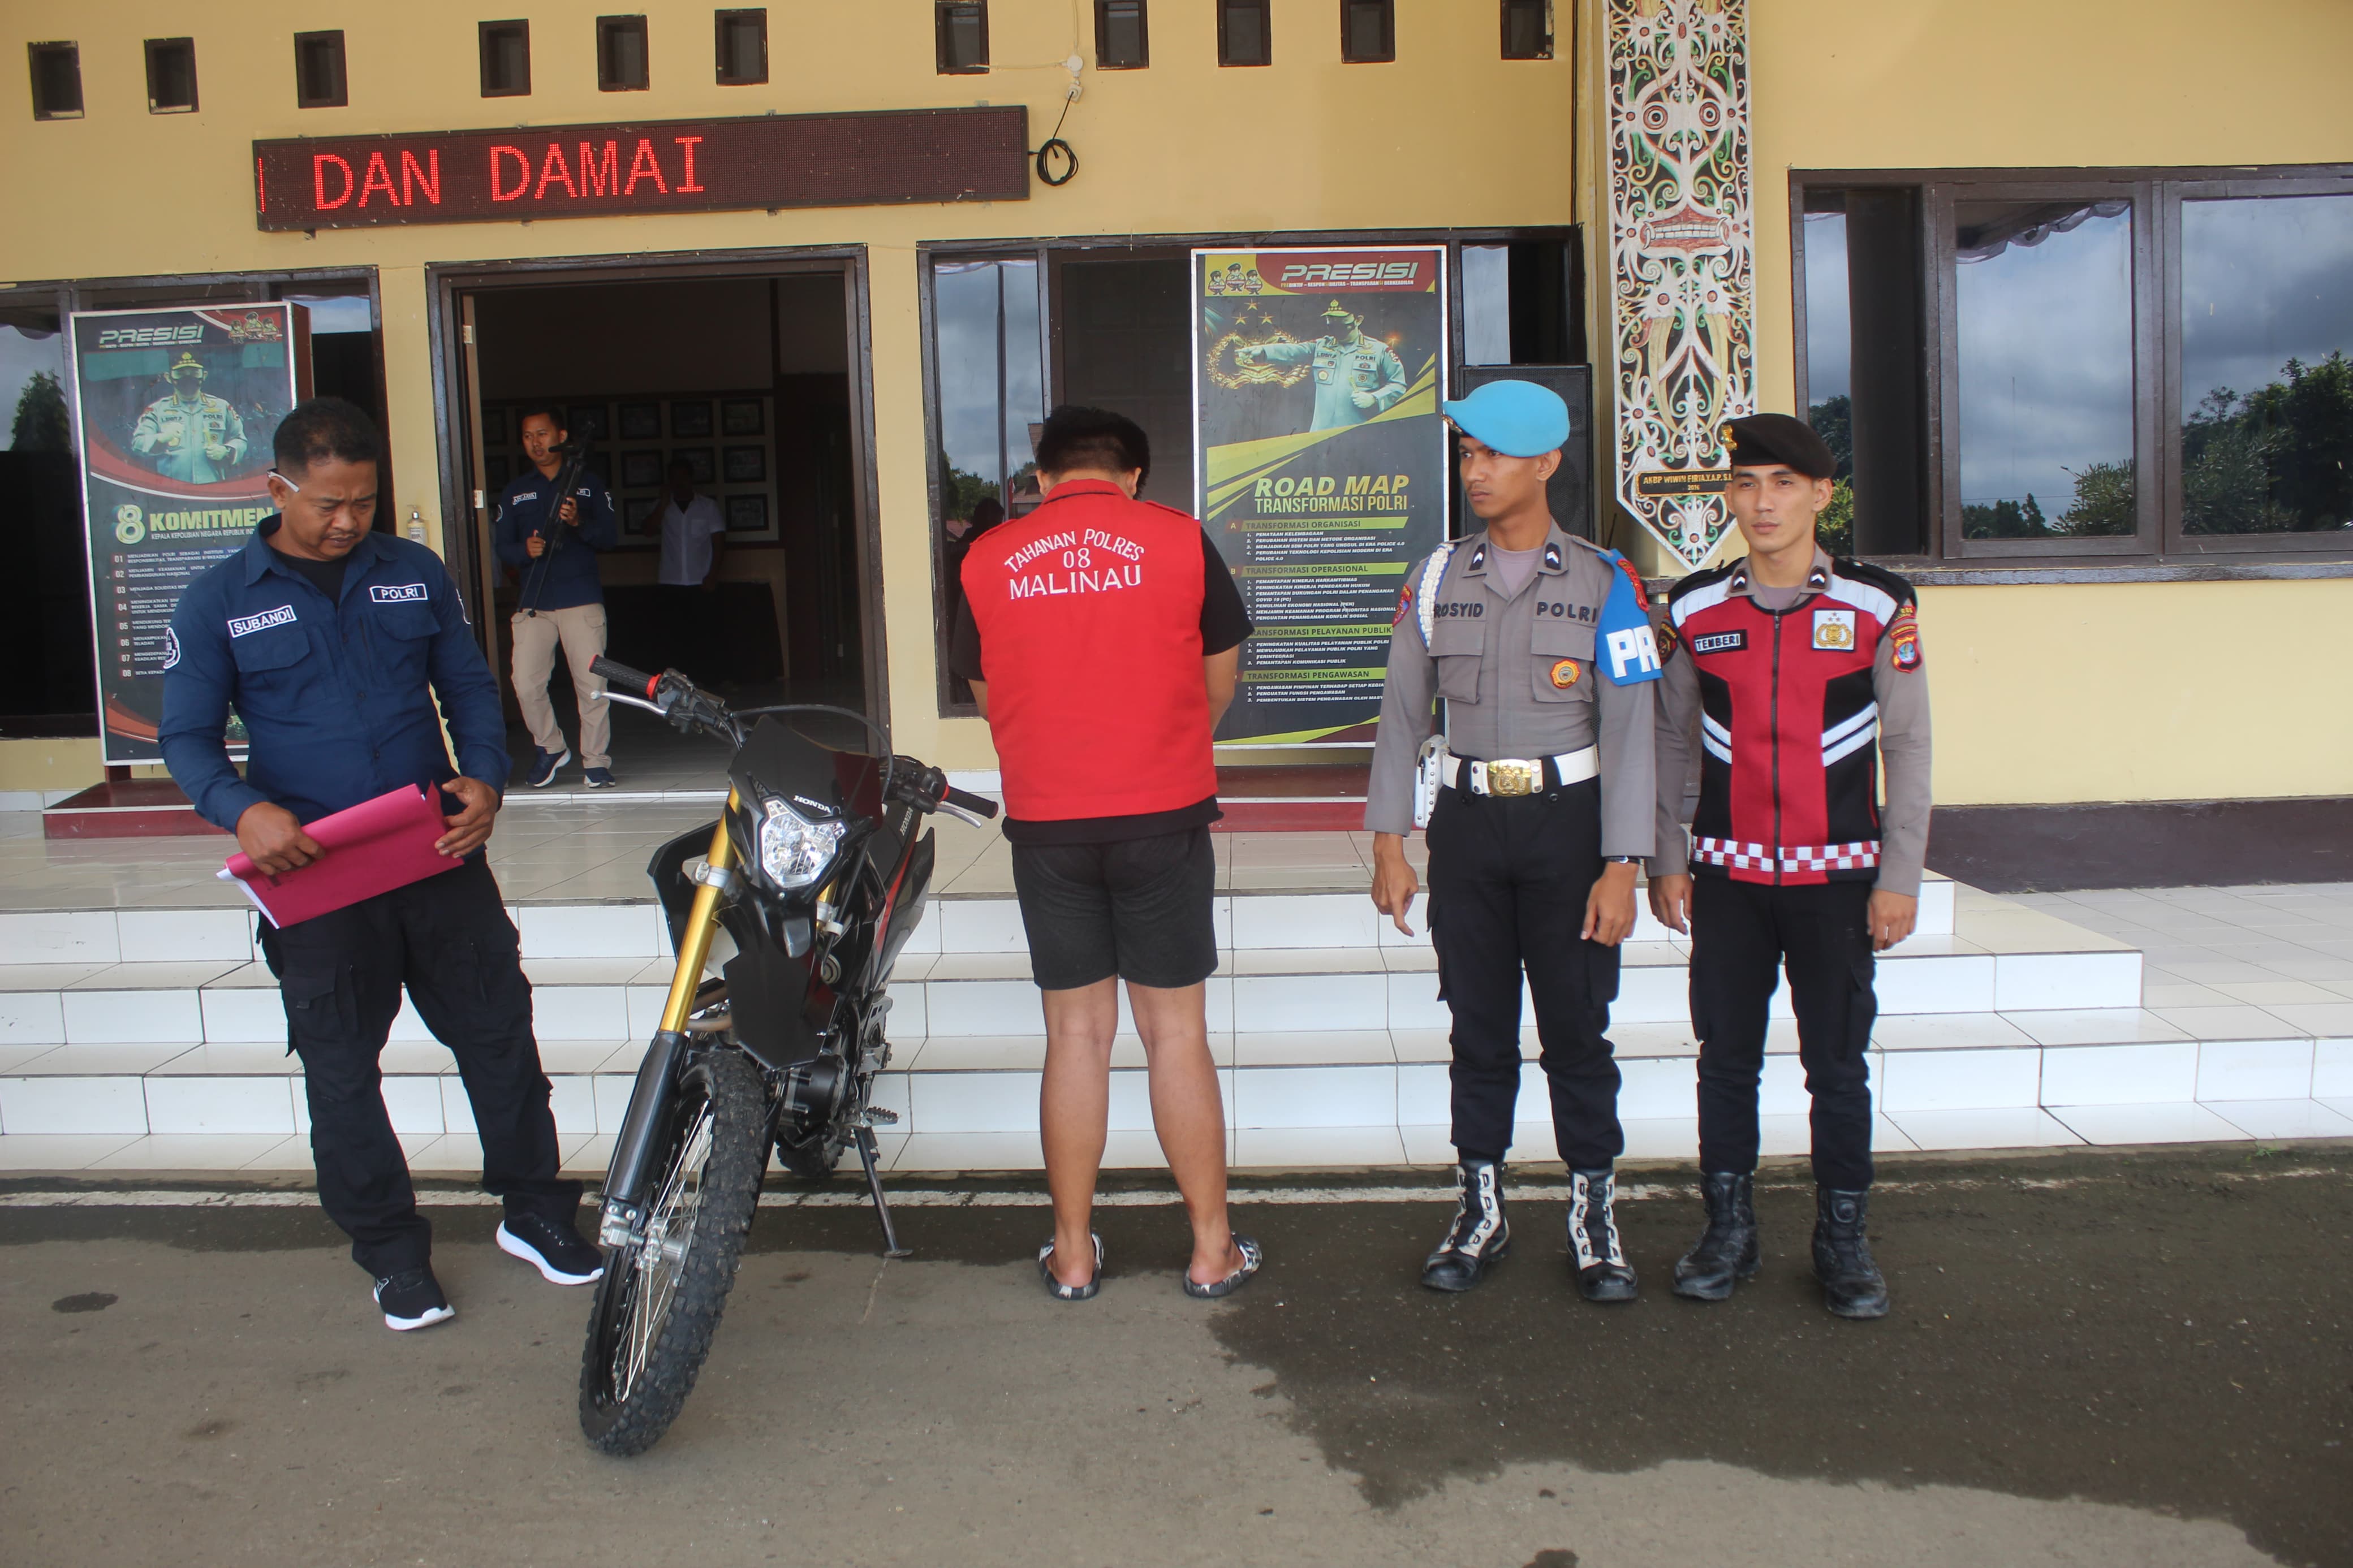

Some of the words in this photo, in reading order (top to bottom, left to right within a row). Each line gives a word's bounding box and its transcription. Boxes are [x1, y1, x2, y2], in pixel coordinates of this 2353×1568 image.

[314, 149, 440, 210] DAN
[490, 136, 705, 202] DAMAI
[1281, 262, 1419, 281] PRESISI
[100, 326, 204, 344] PRESISI
[1254, 477, 1336, 497] ROAD
[1343, 475, 1410, 495] MAP
[1255, 496, 1363, 513] TRANSFORMASI
[1368, 495, 1407, 511] POLRI
[115, 504, 146, 544] 8
[1004, 530, 1076, 573] TAHANAN
[1083, 528, 1145, 561] POLRES
[1063, 547, 1091, 568] 08
[1009, 564, 1141, 599] MALINAU
[381, 586, 419, 599] POLRI
[1434, 602, 1484, 618] ROSYID
[1537, 602, 1597, 623] POLRI
[119, 622, 128, 630] 05
[234, 609, 291, 633] SUBANDI
[120, 638, 130, 647] 06
[122, 669, 131, 677] 08
[793, 794, 831, 813] HONDA
[899, 806, 914, 836] HONDA
